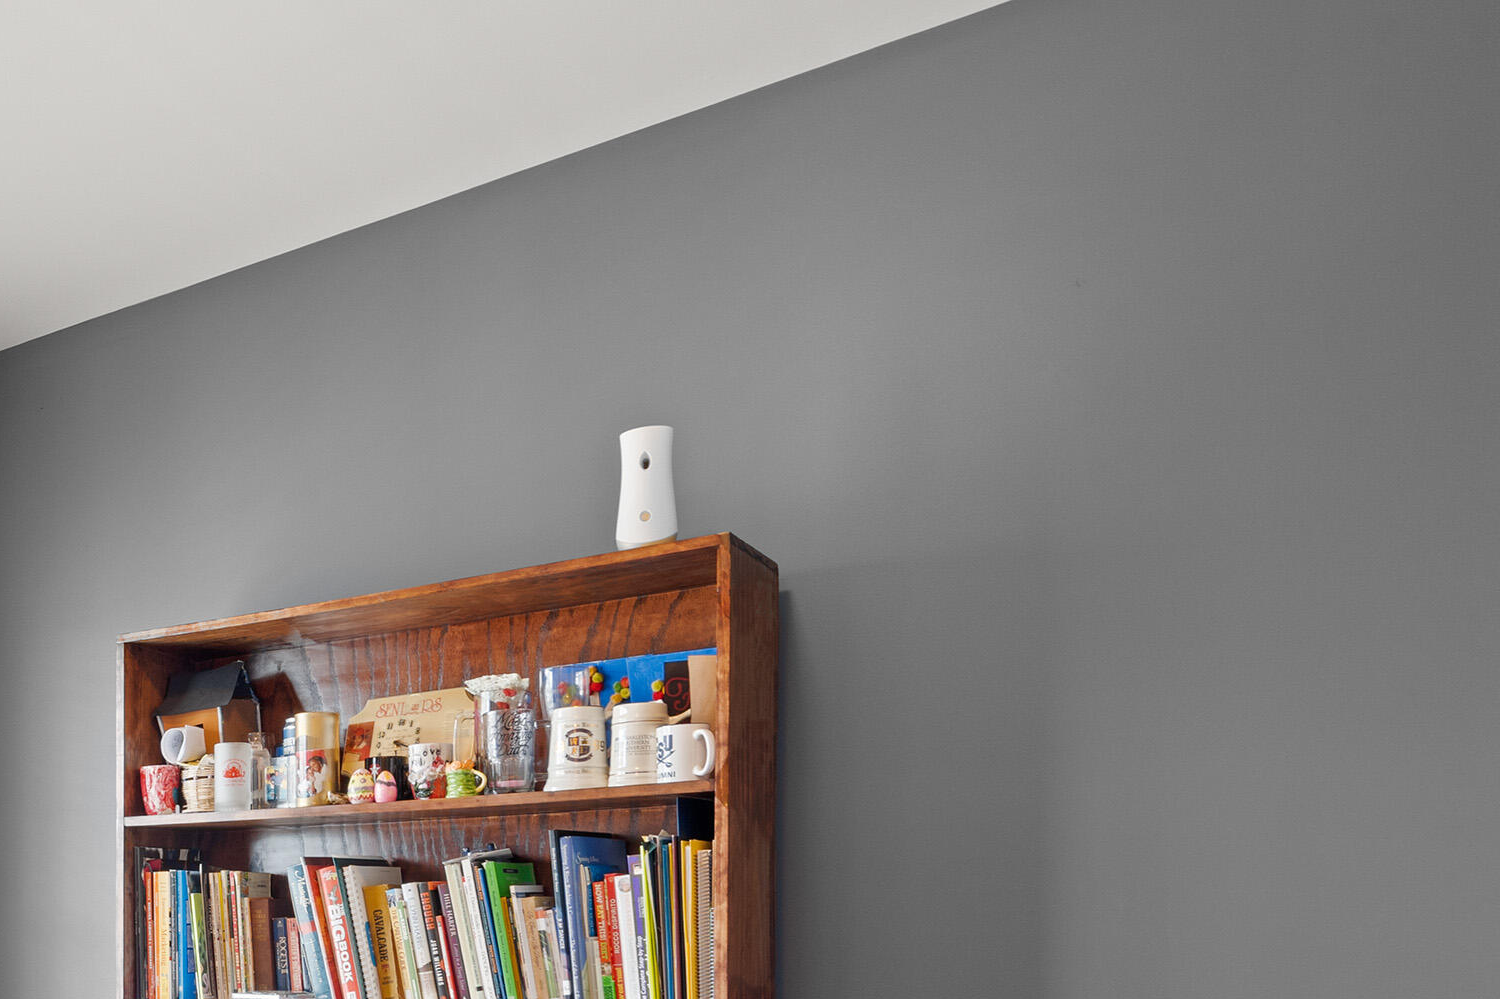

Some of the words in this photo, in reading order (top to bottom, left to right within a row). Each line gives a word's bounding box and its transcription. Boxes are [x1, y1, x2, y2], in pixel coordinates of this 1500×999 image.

[443, 893, 452, 909] HILL
[594, 884, 603, 904] NOW
[420, 892, 435, 930] ENOUGH
[597, 904, 605, 920] EAT
[610, 899, 619, 929] DISPIRITO
[445, 910, 457, 937] HARPER
[598, 920, 607, 940] THIS!
[328, 904, 346, 941] BIG
[339, 941, 354, 984] BOOK
[372, 909, 389, 962] CAVALCADE
[613, 932, 621, 954] ROCCO
[430, 939, 438, 955] JUAN
[600, 942, 609, 960] DIET
[433, 956, 444, 986] WILLIAMS
[639, 972, 647, 994] Complete
